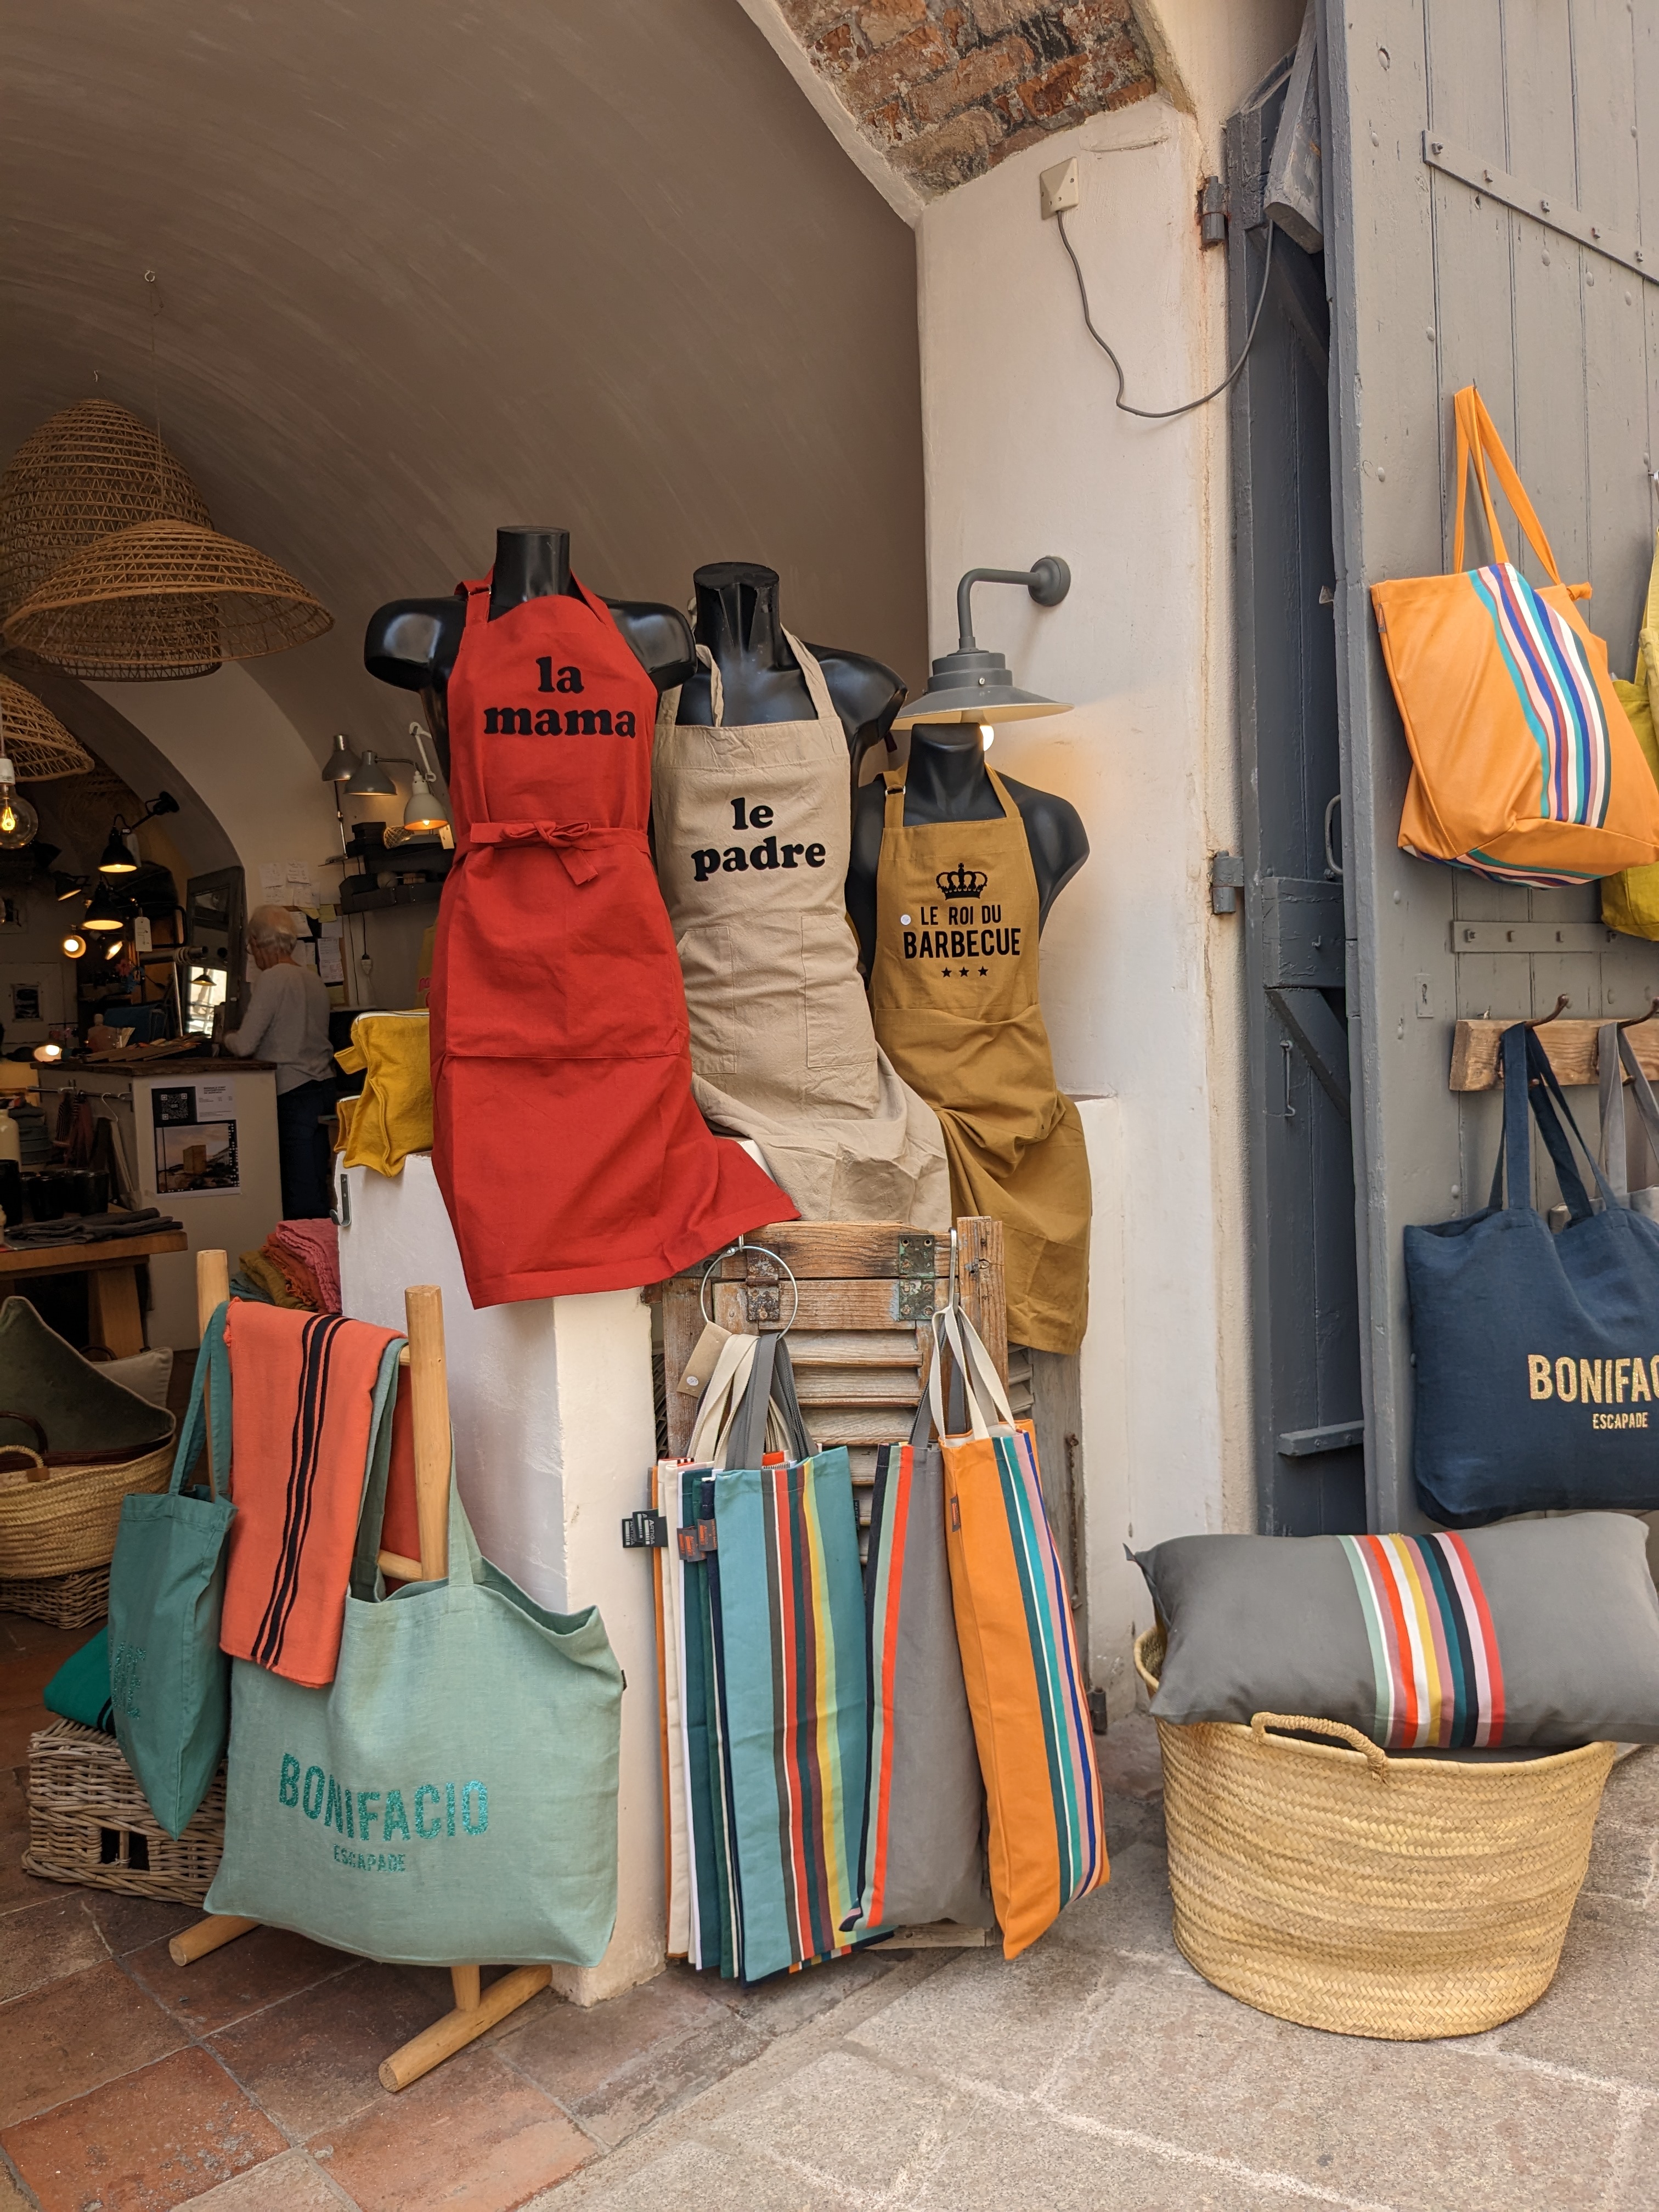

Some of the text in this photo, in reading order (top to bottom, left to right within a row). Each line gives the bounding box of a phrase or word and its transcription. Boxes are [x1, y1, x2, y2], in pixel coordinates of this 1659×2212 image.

[535, 656, 585, 694] la
[483, 707, 636, 739] mama
[730, 797, 774, 831] le
[691, 836, 826, 882] padre
[920, 906, 939, 926] LE
[949, 906, 974, 926] ROI
[981, 904, 1002, 924] DU
[903, 928, 1021, 960] BARBECUE
[1592, 1412, 1649, 1430] ESCAPADE
[279, 1752, 489, 1842] BONIFACIO
[333, 1843, 406, 1872] ESCAPADE
